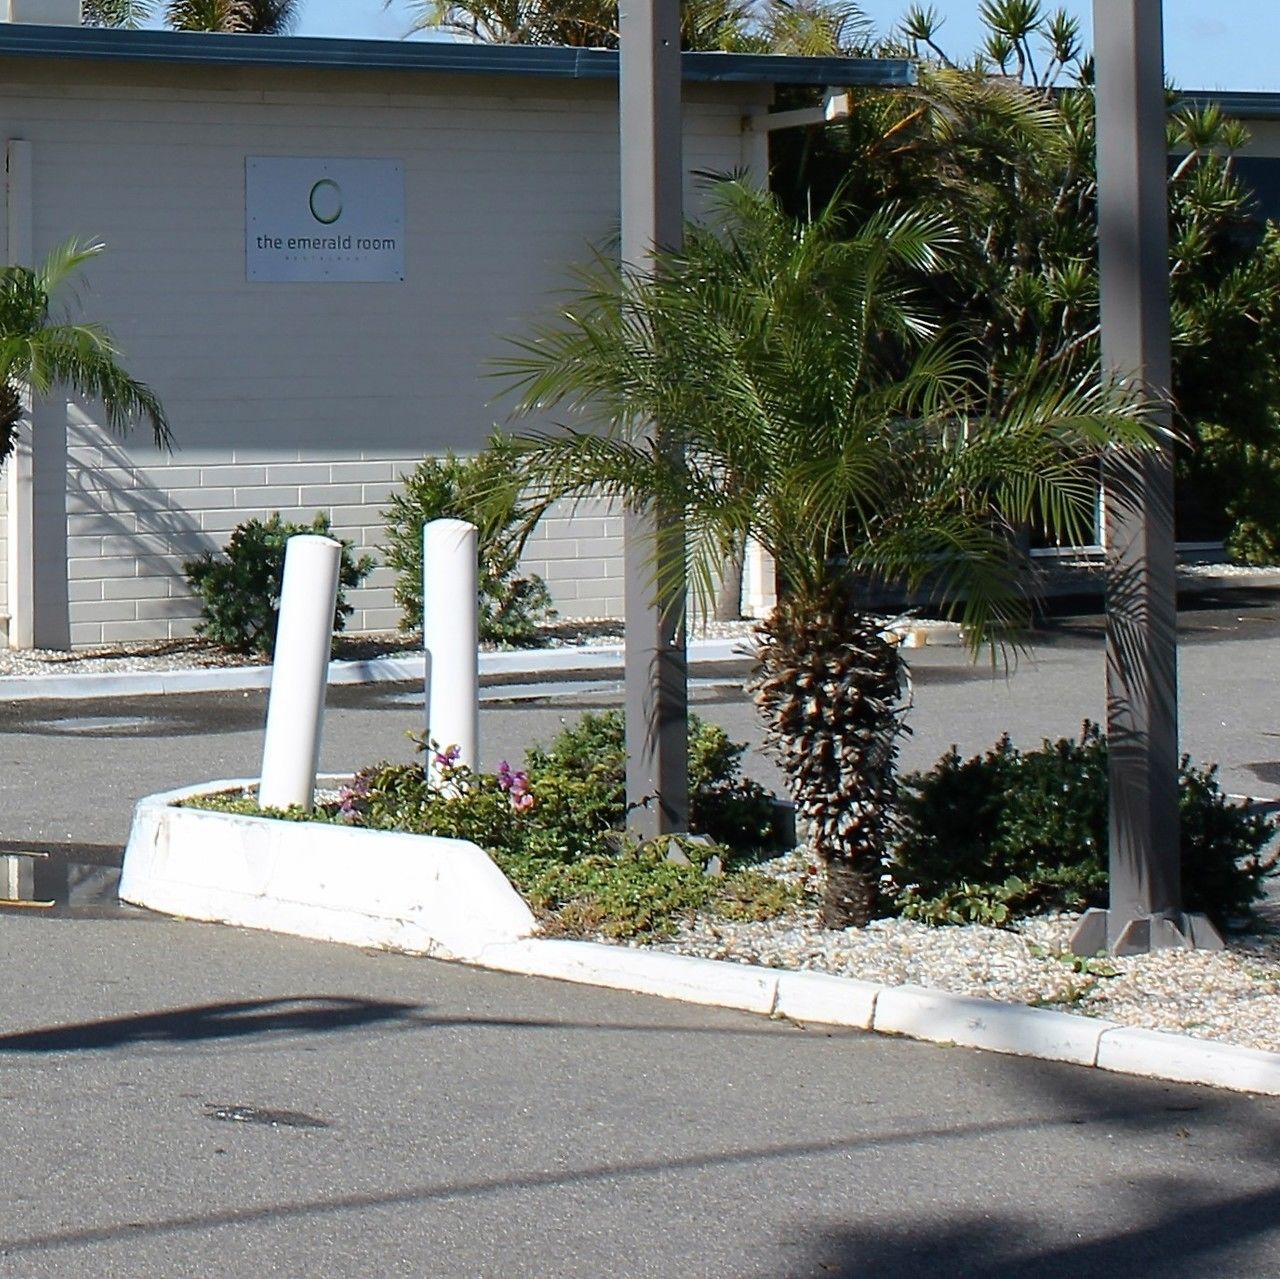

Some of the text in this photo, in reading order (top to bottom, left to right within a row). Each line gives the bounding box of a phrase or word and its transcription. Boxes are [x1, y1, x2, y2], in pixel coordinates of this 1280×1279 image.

[256, 234, 397, 251] the emerald room
